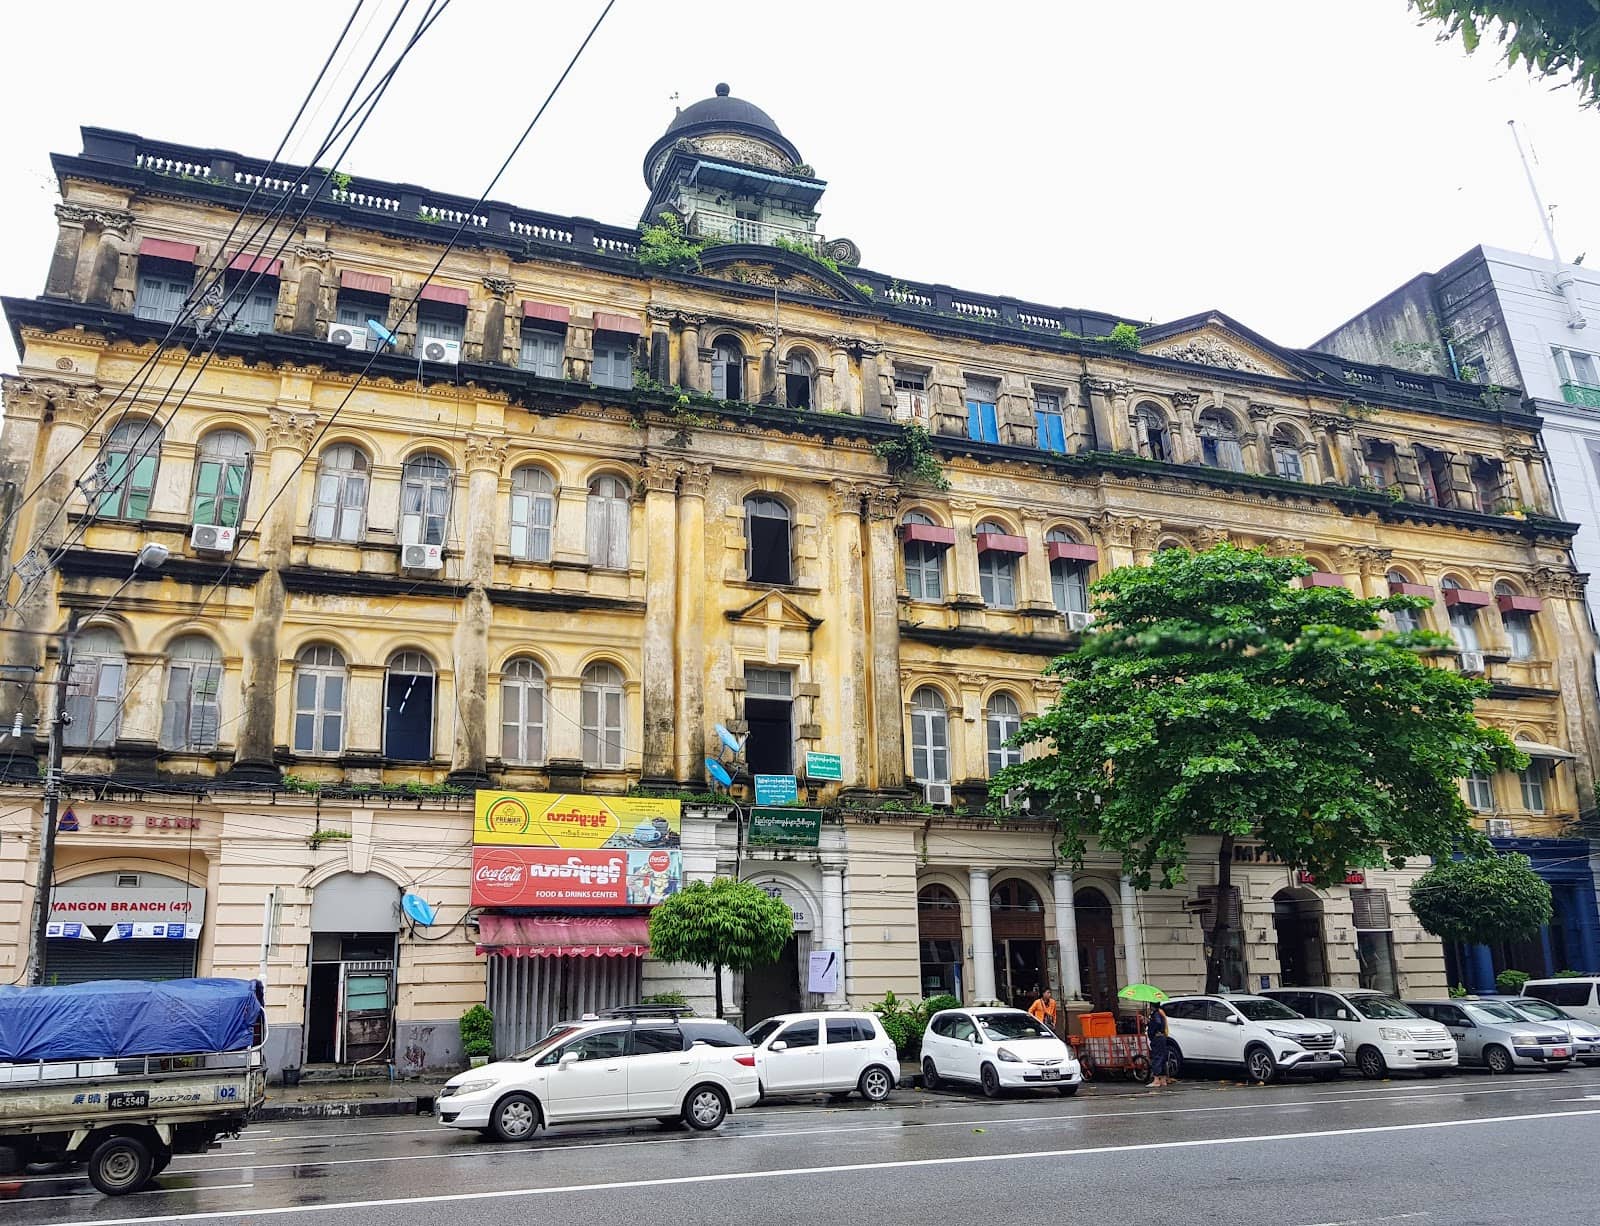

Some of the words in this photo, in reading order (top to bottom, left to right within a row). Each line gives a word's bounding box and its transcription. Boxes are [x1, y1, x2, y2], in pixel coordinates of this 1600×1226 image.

[91, 813, 134, 828] KBZ
[145, 815, 202, 831] BANK
[535, 890, 557, 898] FOOD
[565, 891, 590, 899] DRINKS
[592, 891, 618, 899] CENTER
[52, 902, 107, 911] YANGON
[110, 902, 166, 912] BRANCH
[169, 901, 193, 912] (47)
[220, 1087, 236, 1098] 02
